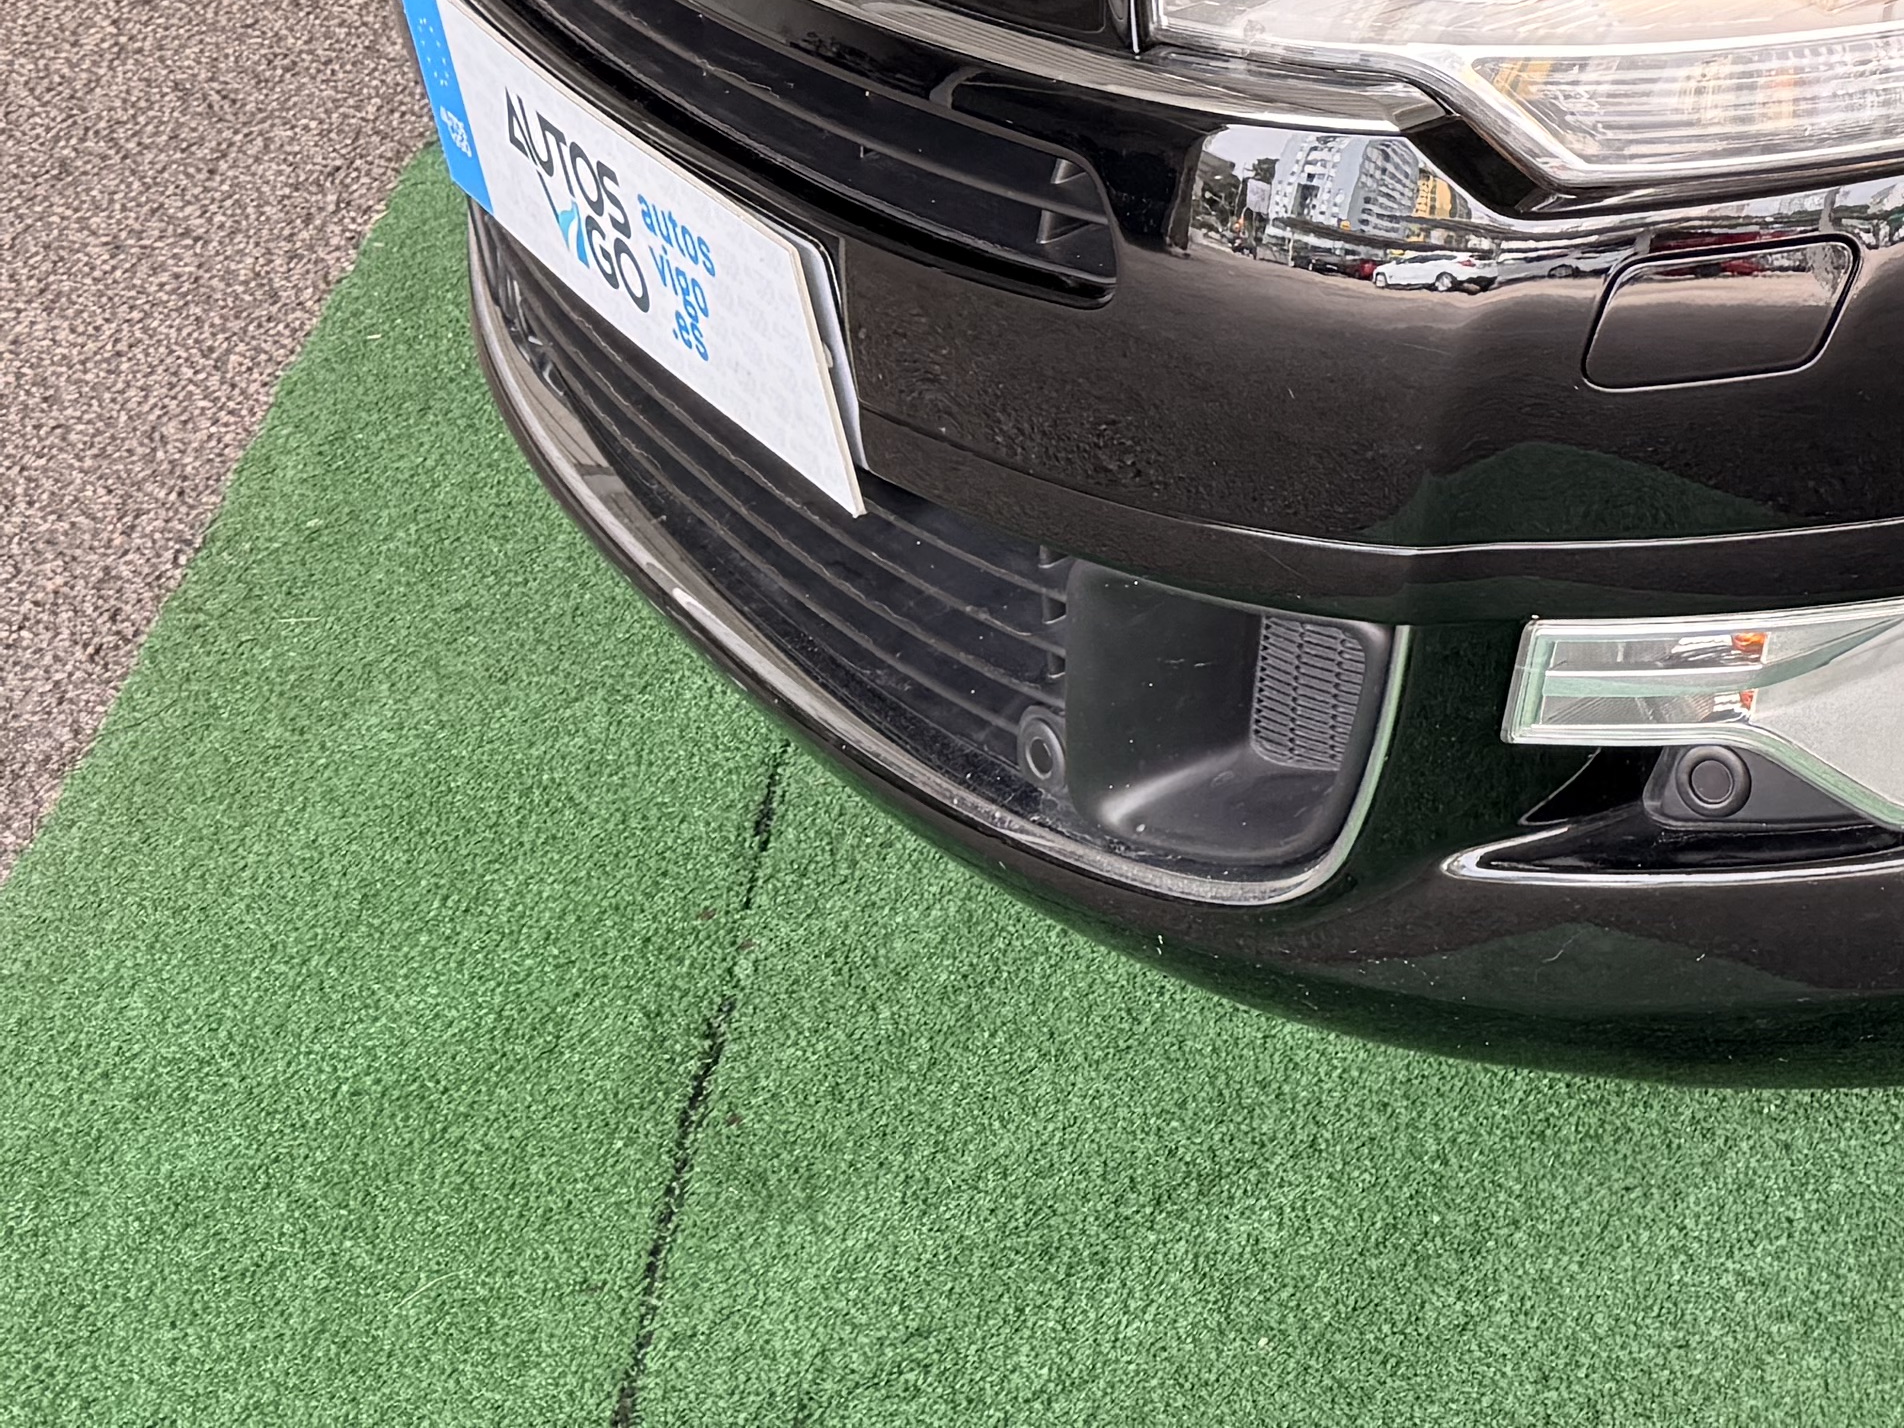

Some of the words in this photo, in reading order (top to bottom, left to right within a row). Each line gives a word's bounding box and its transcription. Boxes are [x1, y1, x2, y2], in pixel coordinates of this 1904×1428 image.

[506, 86, 632, 240] AUTOS
[536, 169, 650, 313] VIGO
[637, 193, 716, 278] autos
[648, 244, 709, 324] vigo
[673, 309, 709, 362] .es
